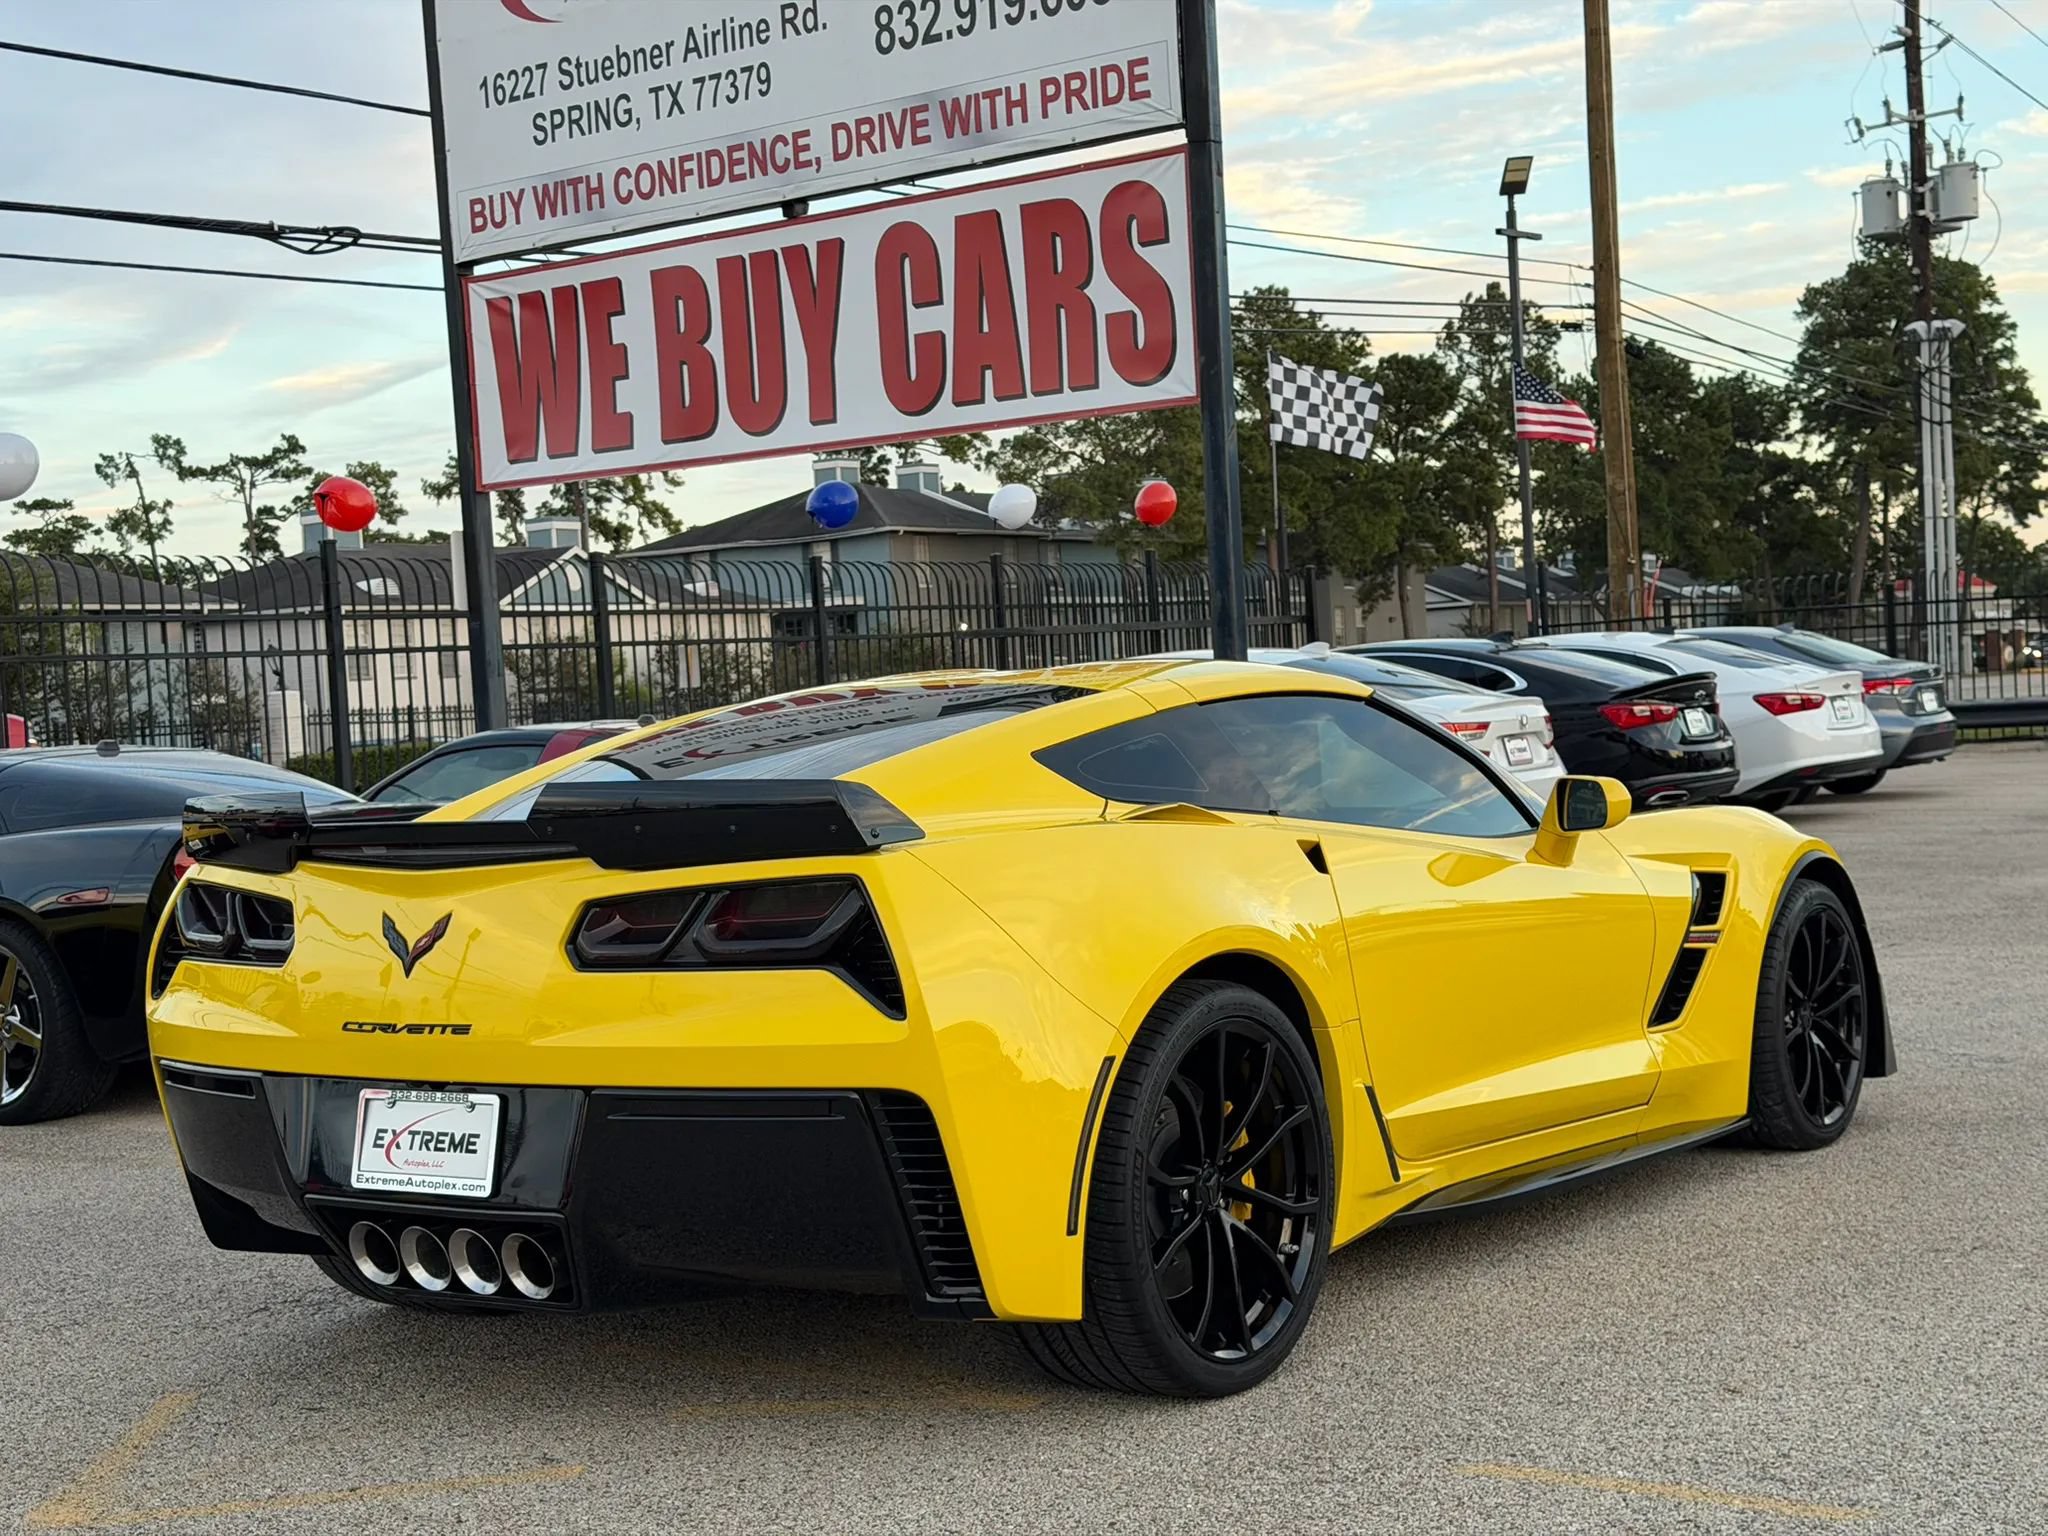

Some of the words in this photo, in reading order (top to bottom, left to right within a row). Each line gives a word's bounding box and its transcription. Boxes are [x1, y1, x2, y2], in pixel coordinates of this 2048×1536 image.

[479, 62, 549, 108] 16227
[558, 40, 675, 92] Stuebner
[682, 16, 771, 63] Airline
[780, 0, 828, 40] Rd.
[874, 0, 1111, 55] 832.919.
[532, 93, 641, 147] SPRING,
[649, 80, 685, 120] TX
[692, 61, 772, 111] 77379
[469, 188, 526, 234] BUY
[532, 172, 605, 220] WITH
[613, 129, 821, 206] CONFIDENCE,
[831, 103, 932, 162] DRIVE
[939, 83, 1029, 140] WITH
[1040, 56, 1151, 119] PRIDE
[485, 276, 634, 465] WE
[650, 237, 845, 445] BUY
[875, 180, 1177, 417] CARS
[341, 1021, 472, 1035] CORVETTE
[372, 1128, 481, 1155] EXTREME
[356, 1173, 487, 1193] ExtremeAutoplex.com
